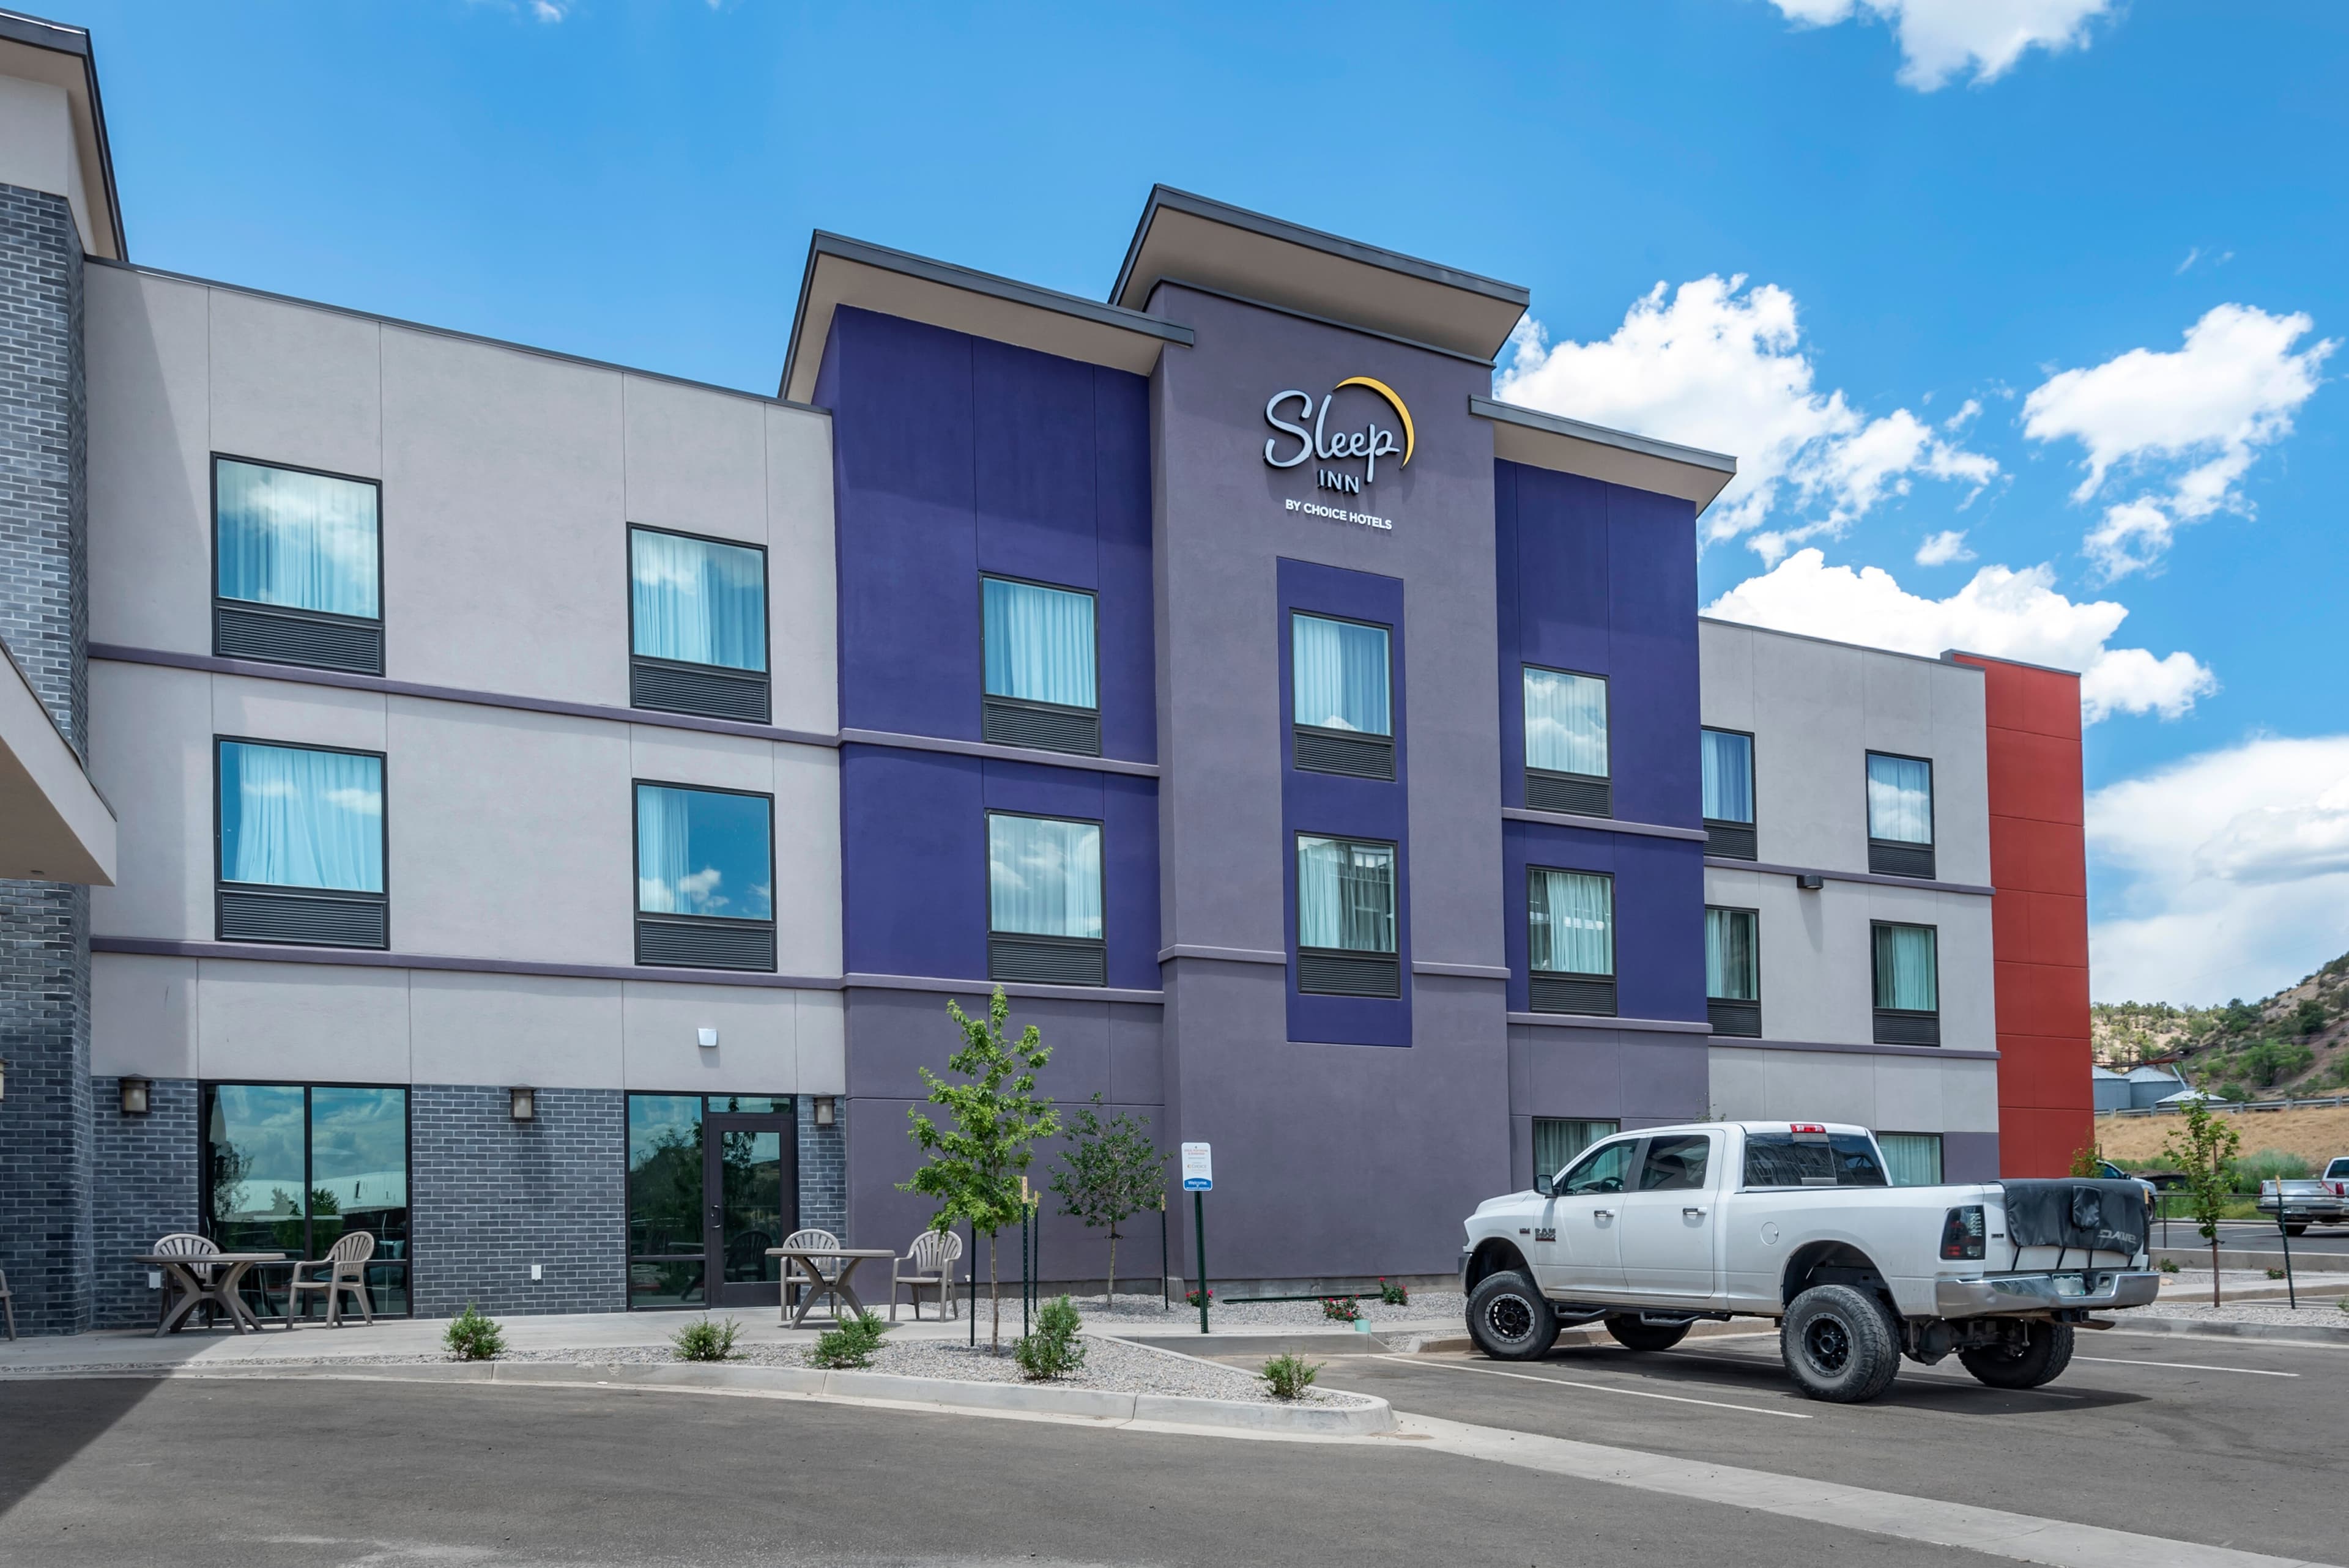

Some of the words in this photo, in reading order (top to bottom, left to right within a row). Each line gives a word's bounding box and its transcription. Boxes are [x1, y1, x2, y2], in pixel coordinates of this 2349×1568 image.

[1263, 390, 1400, 484] Sleep
[1317, 469, 1359, 495] INN
[1285, 499, 1301, 511] BY
[1303, 503, 1347, 520] CHOICE
[1349, 512, 1392, 530] HOTELS
